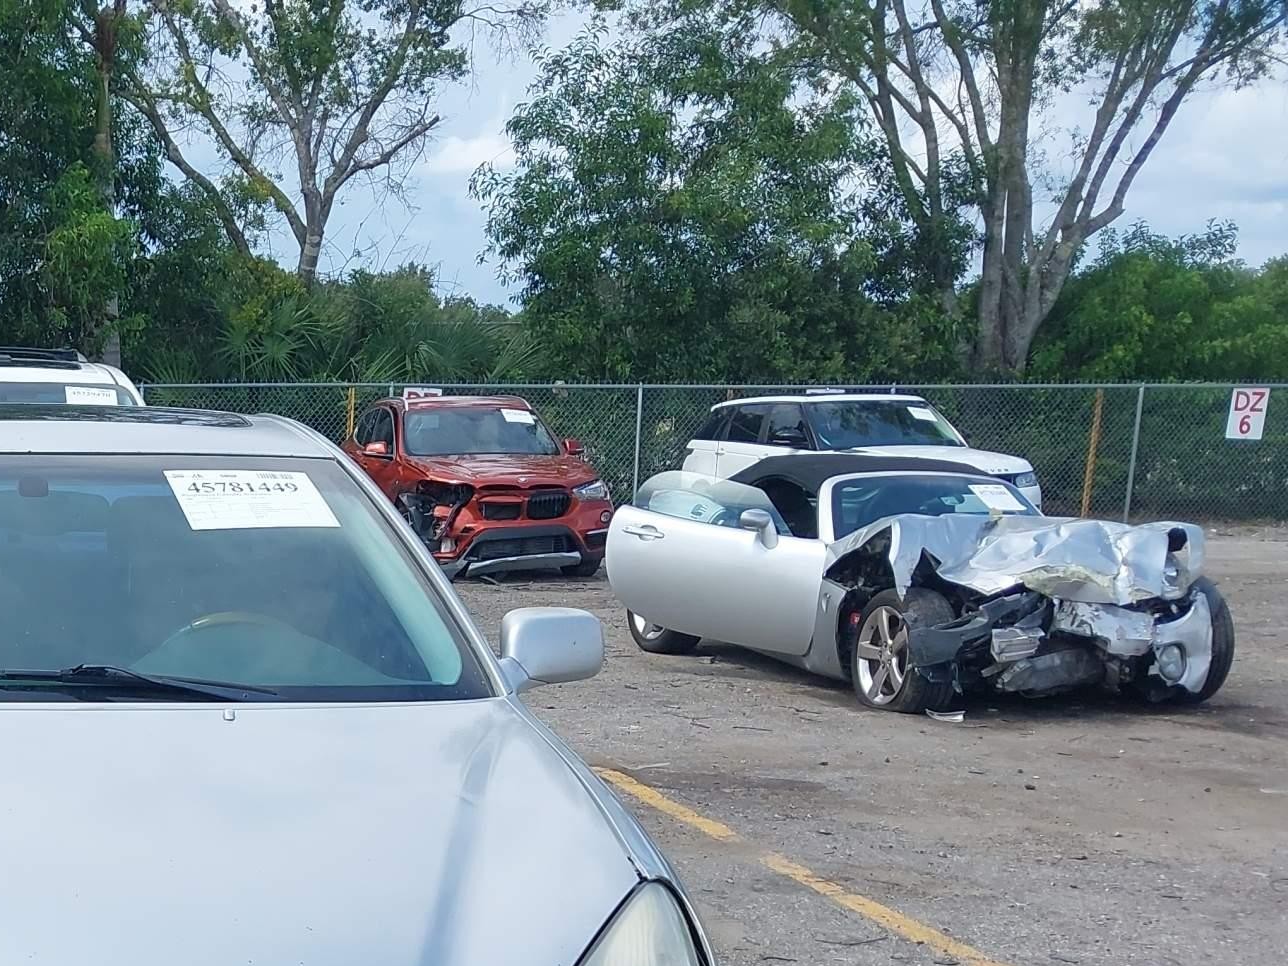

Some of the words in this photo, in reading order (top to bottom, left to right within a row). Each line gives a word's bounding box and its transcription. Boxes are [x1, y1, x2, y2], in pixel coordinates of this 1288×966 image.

[1234, 391, 1266, 412] DZ
[1239, 414, 1252, 435] 6
[187, 482, 299, 493] 45781449
